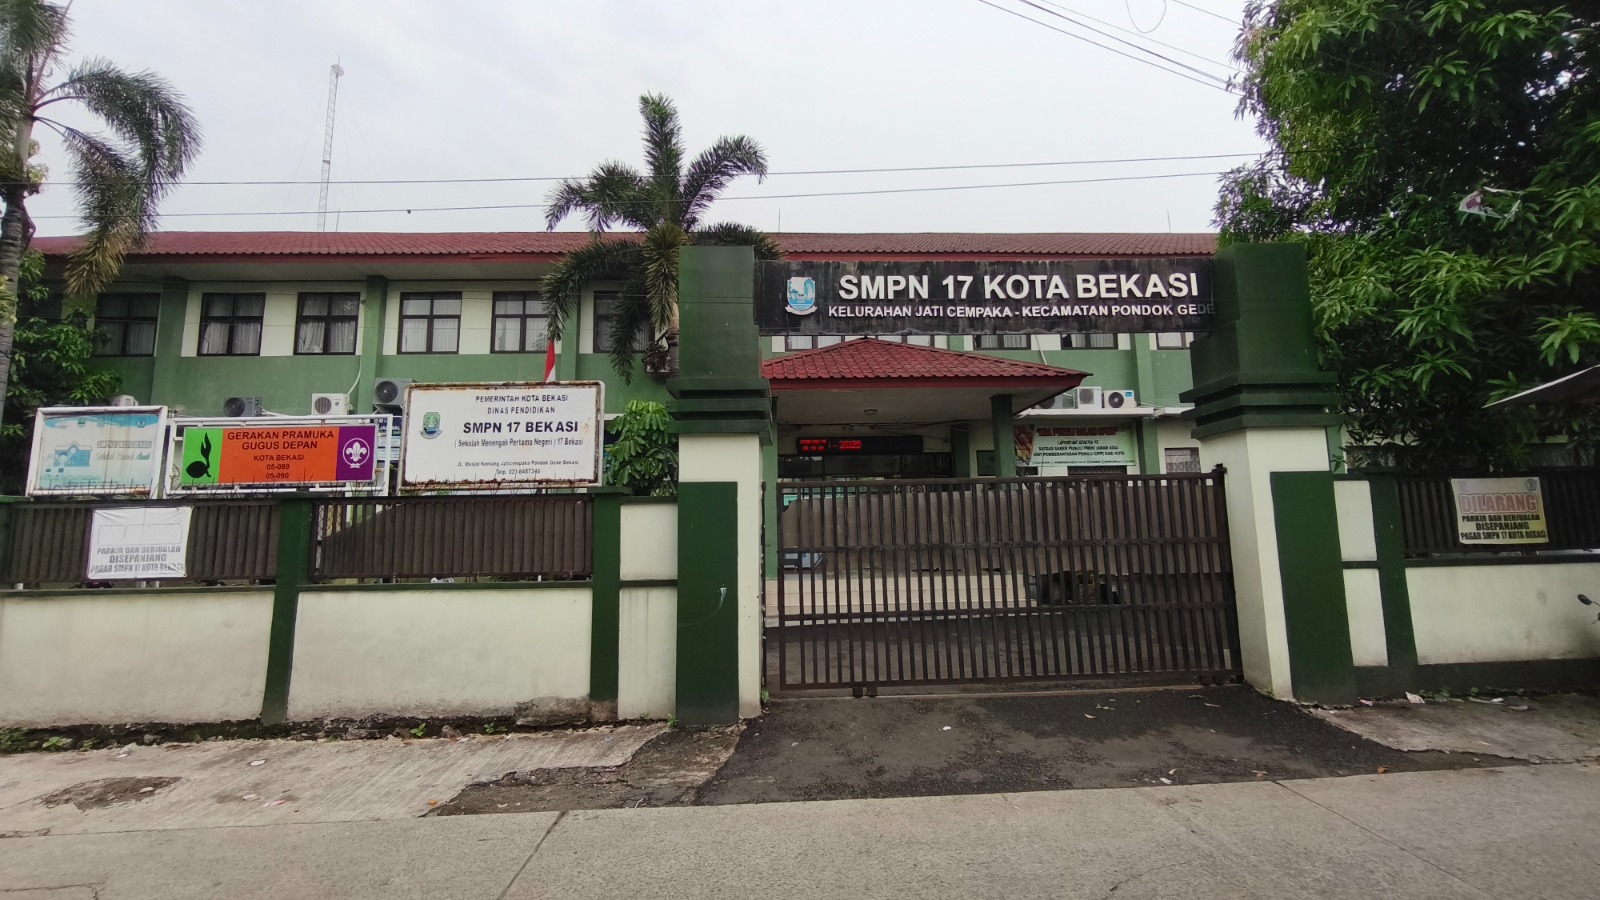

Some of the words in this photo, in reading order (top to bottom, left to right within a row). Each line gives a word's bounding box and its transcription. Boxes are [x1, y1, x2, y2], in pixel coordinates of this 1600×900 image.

[839, 275, 928, 299] SMPN
[942, 275, 973, 299] 17
[984, 275, 1069, 299] KOTA
[1076, 273, 1198, 299] BEKASI
[828, 306, 911, 317] KELURAHAN
[916, 306, 943, 317] JATI
[947, 306, 1011, 318] CEMPAKA
[1022, 306, 1107, 317] KECAMATAN
[1112, 305, 1173, 316] PONDOK
[1177, 304, 1216, 315] GEDE
[463, 422, 502, 433] SMPN
[506, 422, 520, 433] 17
[526, 421, 578, 432] BEKASI
[227, 432, 280, 440] GERAKAN
[282, 431, 335, 439] PRAMUKA
[242, 442, 280, 450] GUGUS
[283, 441, 318, 449] DEPAN
[481, 439, 508, 448] Menengah
[509, 438, 533, 446] Pertama
[534, 438, 552, 447] Negeri
[564, 437, 583, 445] Bekasi
[1459, 493, 1537, 514] DILARANG
[1475, 522, 1530, 531] DISEPANJANG
[1461, 532, 1482, 540] PAGAR
[1482, 531, 1500, 540] SMPN
[1501, 531, 1507, 539] 17
[1508, 531, 1524, 539] KOTA
[109, 554, 167, 563] DISEPANJANG
[113, 564, 133, 572] SMPN
[141, 563, 159, 571] KOTA
